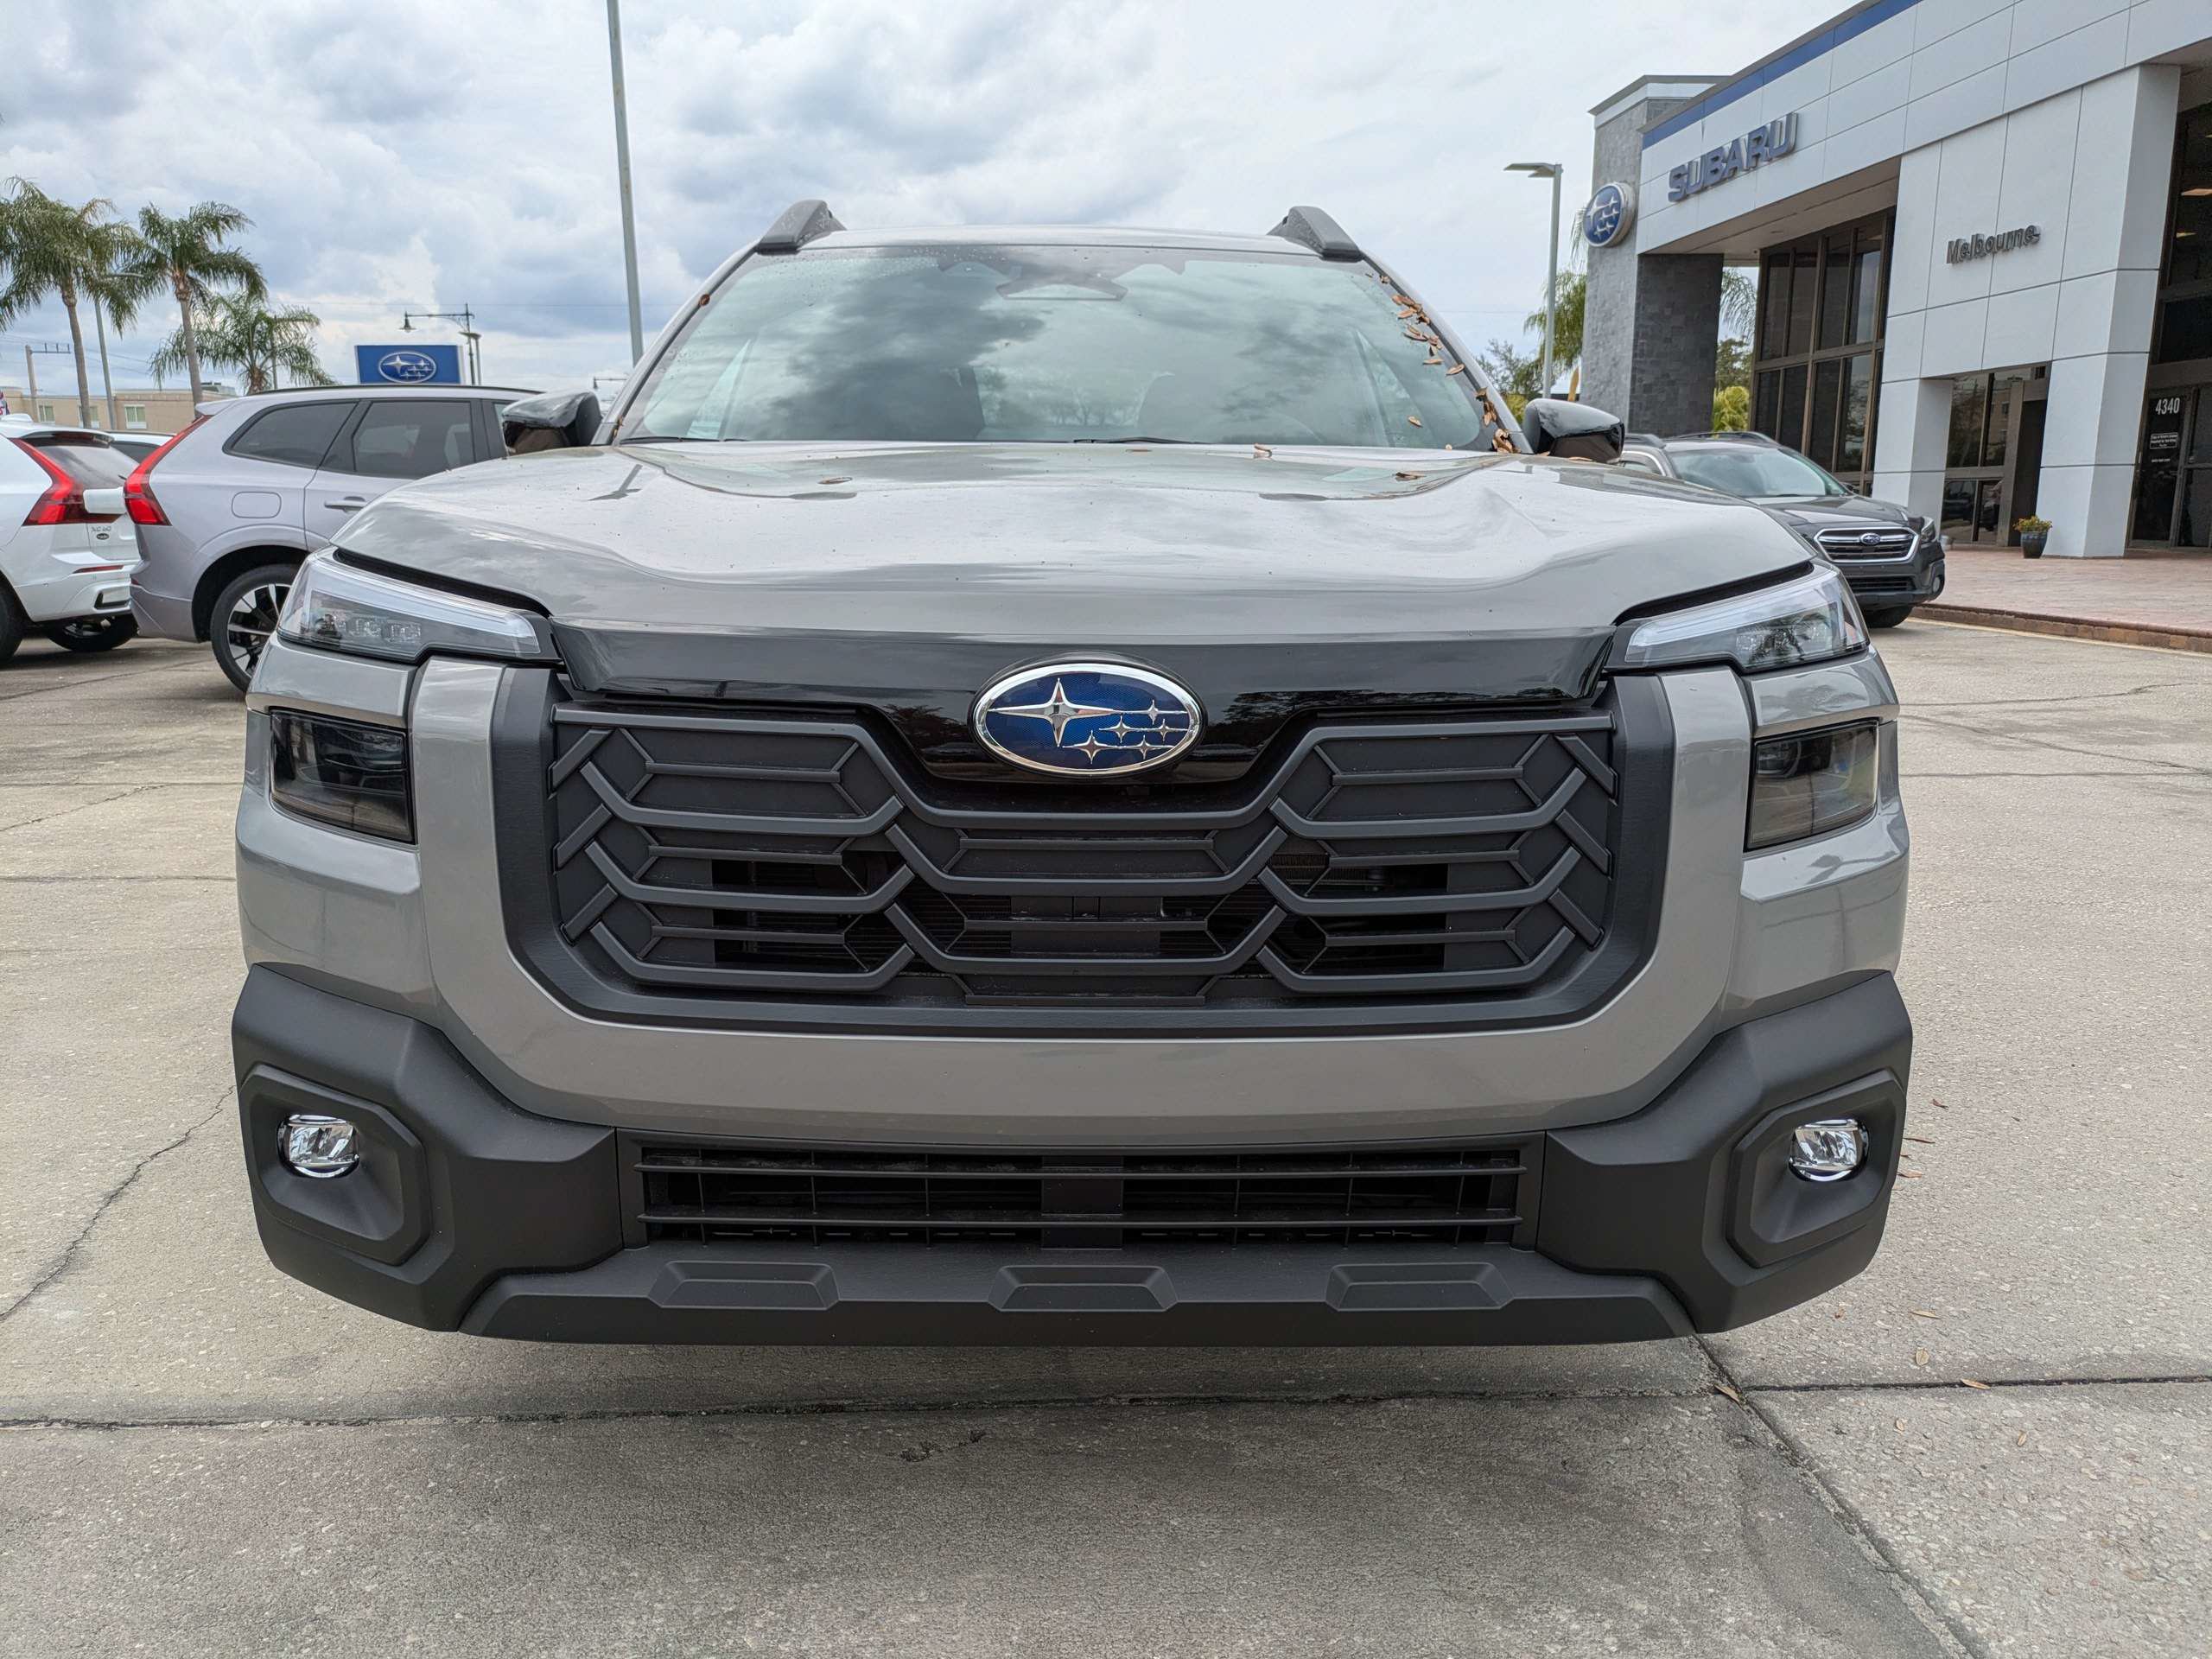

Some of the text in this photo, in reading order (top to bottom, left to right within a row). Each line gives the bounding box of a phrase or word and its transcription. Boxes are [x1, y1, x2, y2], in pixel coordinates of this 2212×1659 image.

[1668, 112, 1799, 202] SUBARU
[1947, 225, 2040, 264] Melbourne
[2155, 397, 2180, 415] 4340
